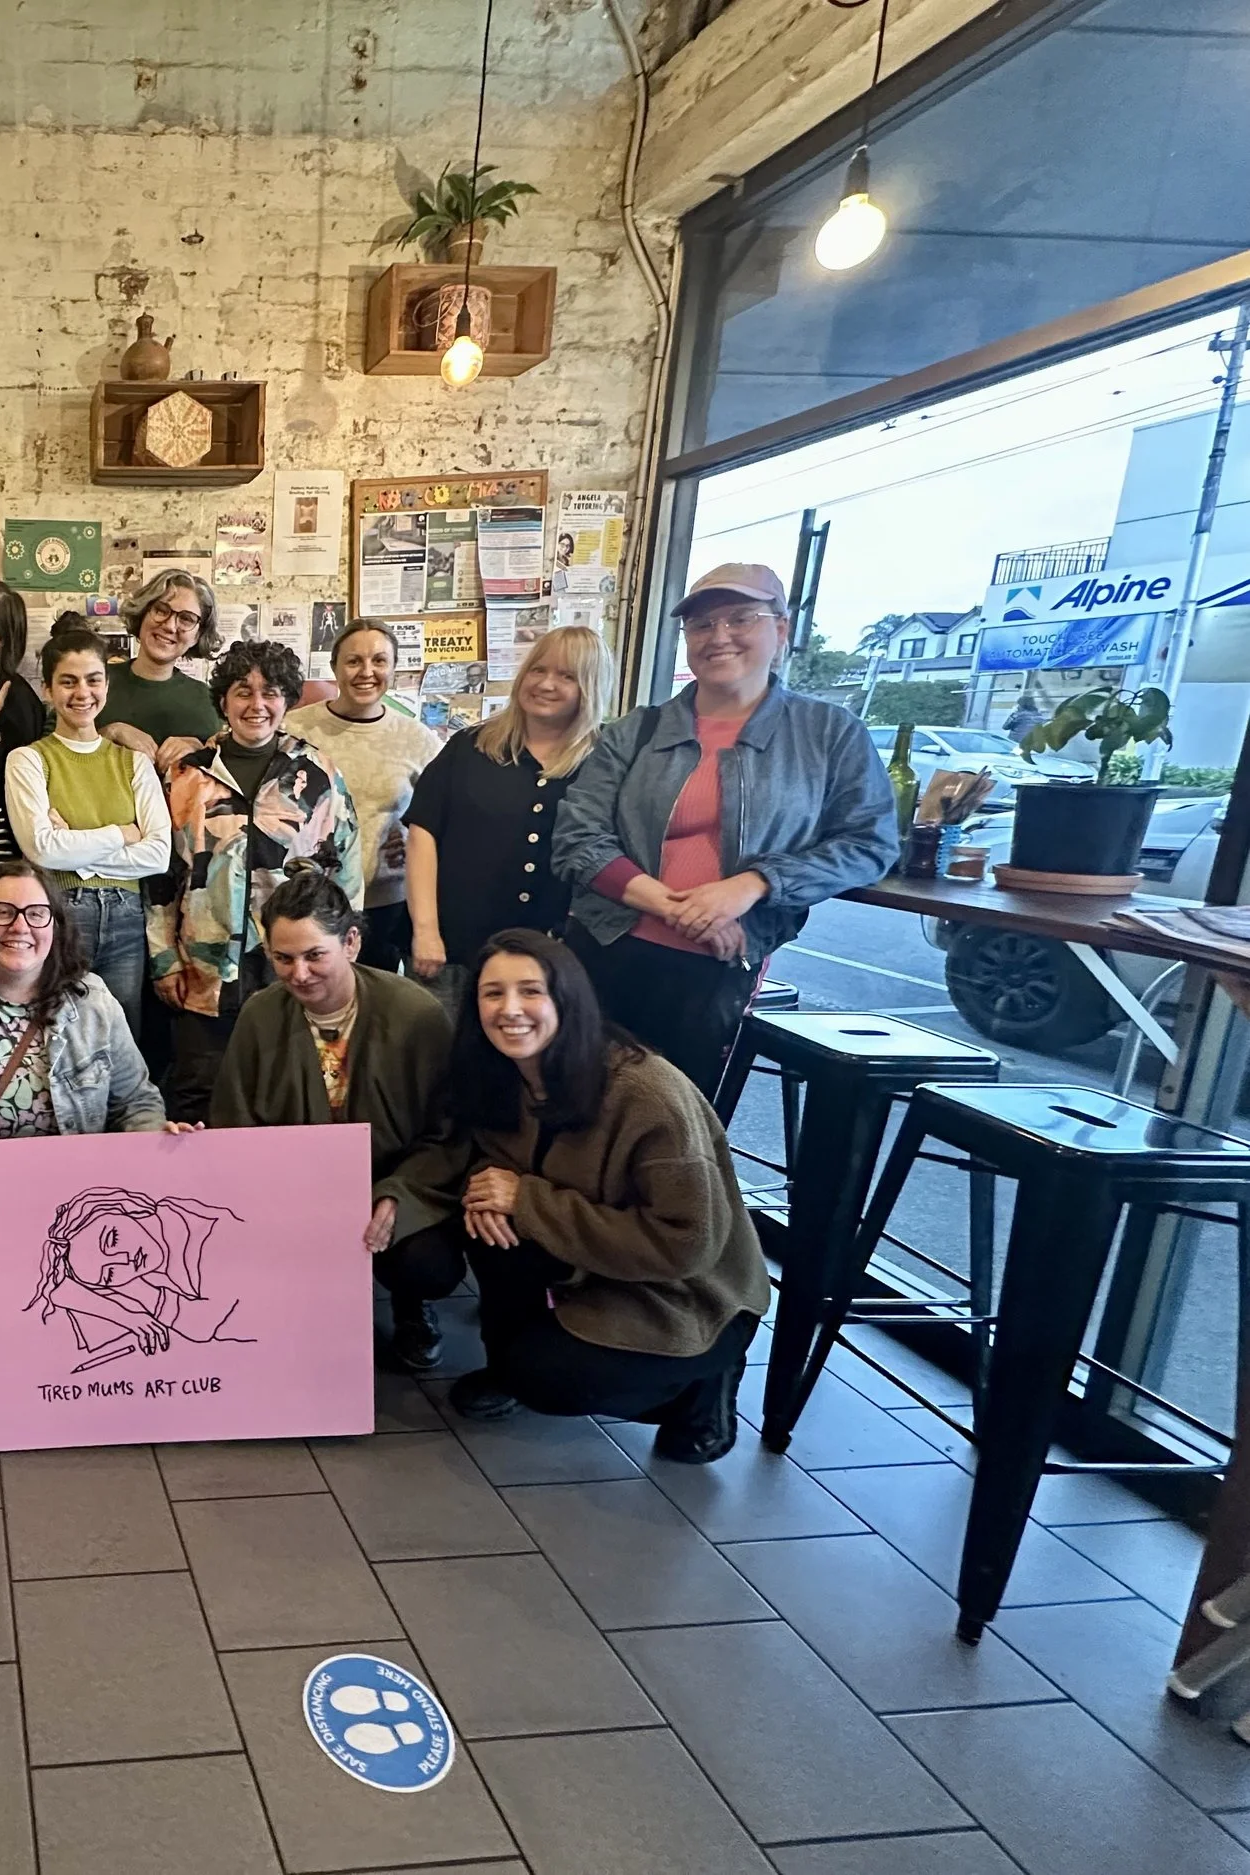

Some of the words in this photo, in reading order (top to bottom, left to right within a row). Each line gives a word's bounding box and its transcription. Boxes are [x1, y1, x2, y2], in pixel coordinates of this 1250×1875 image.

[1050, 574, 1172, 612] Alpine
[424, 636, 473, 647] TREATY
[435, 628, 465, 636] SUPPORT
[1022, 633, 1067, 645] TOUCH
[38, 1384, 82, 1402] TIRED
[88, 1381, 134, 1397] MUMS
[145, 1379, 177, 1398] ART
[182, 1377, 221, 1394] CLUB
[376, 1665, 411, 1690] HERE
[310, 1672, 336, 1743] DISTANCING
[411, 1690, 442, 1731] STAND
[332, 1745, 368, 1773] SAFE
[417, 1734, 445, 1775] PLEASE
